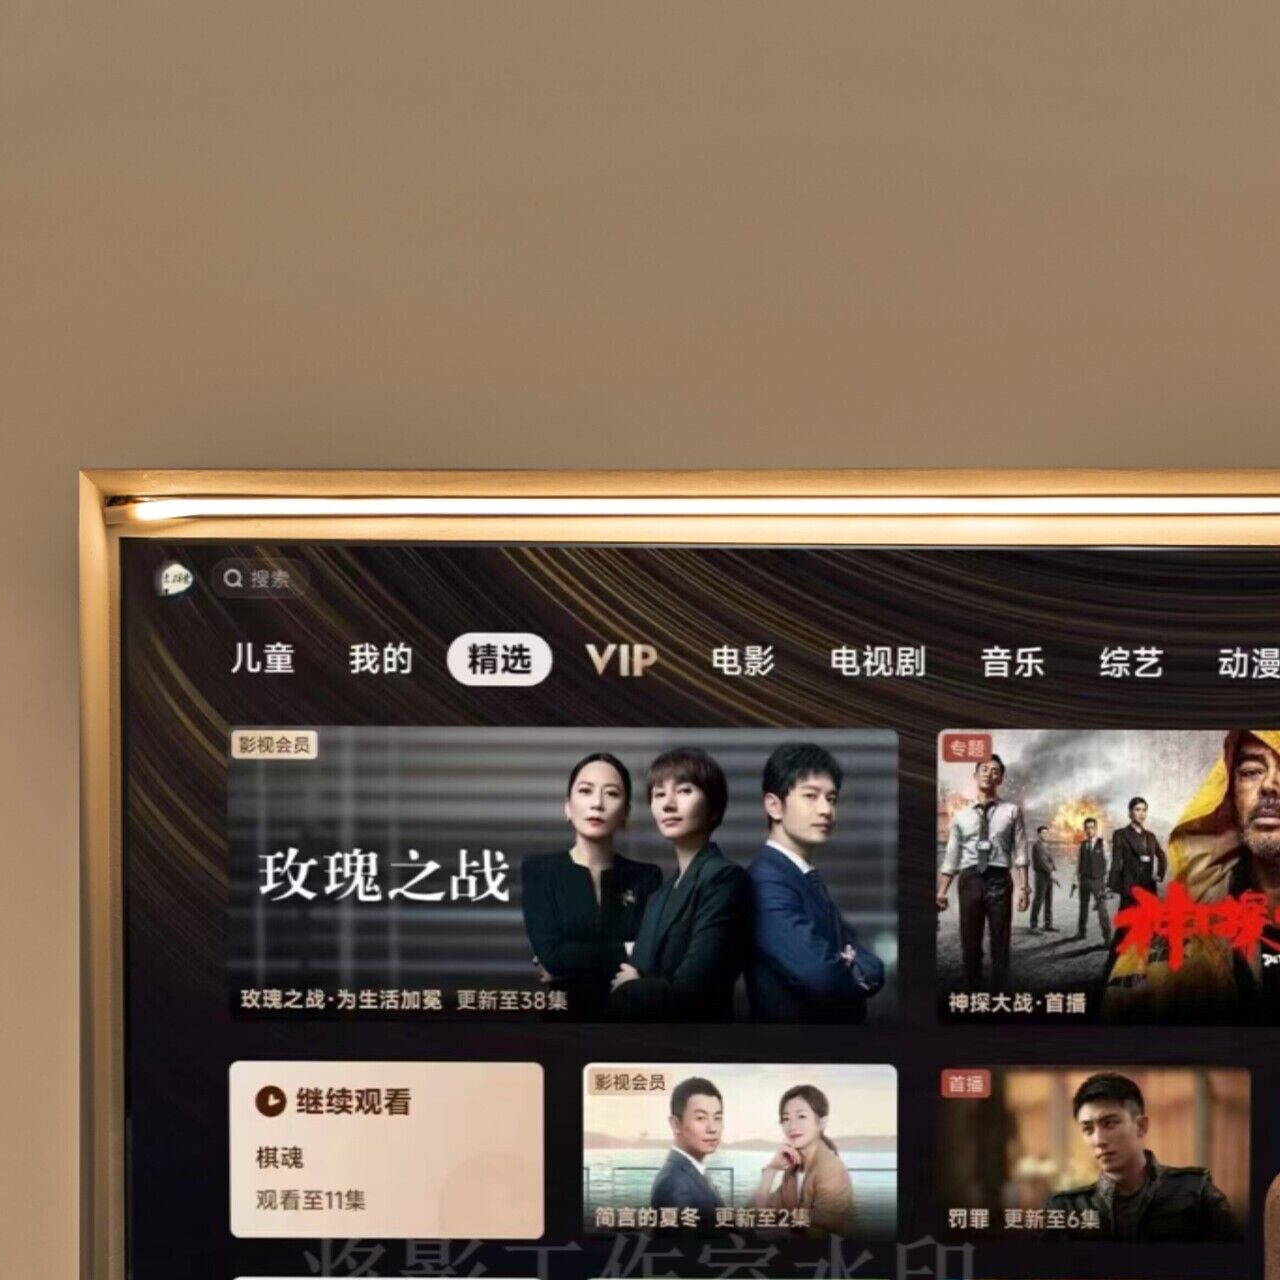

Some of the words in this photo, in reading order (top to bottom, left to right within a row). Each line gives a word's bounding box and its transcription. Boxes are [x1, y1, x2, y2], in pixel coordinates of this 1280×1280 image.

[251, 569, 290, 589] 搜索
[230, 642, 295, 675] 儿童
[348, 642, 413, 676] 我的
[467, 642, 533, 676] 精选
[585, 644, 658, 677] VIP
[711, 644, 776, 677] 电影
[831, 645, 926, 677] 电视剧
[981, 646, 1045, 679] 音乐
[1099, 647, 1164, 680] 综艺
[238, 736, 311, 754] 影视会员
[949, 737, 985, 760] 专题
[257, 846, 511, 904] 玫瑰之战
[456, 989, 568, 1012] 更新至38集
[948, 992, 1087, 1015] 神探大战·首播
[594, 1073, 666, 1092] 影视会员
[948, 1074, 984, 1095] 首播
[296, 1087, 412, 1117] 继续观看
[256, 1145, 305, 1171] 棋魂
[256, 1188, 367, 1212] 观看至11集
[595, 1206, 701, 1229] 简言的夏冬
[714, 1206, 811, 1229] 更新至2集
[948, 1208, 990, 1231] 罚罪
[1003, 1208, 1101, 1231] 更新至6集
